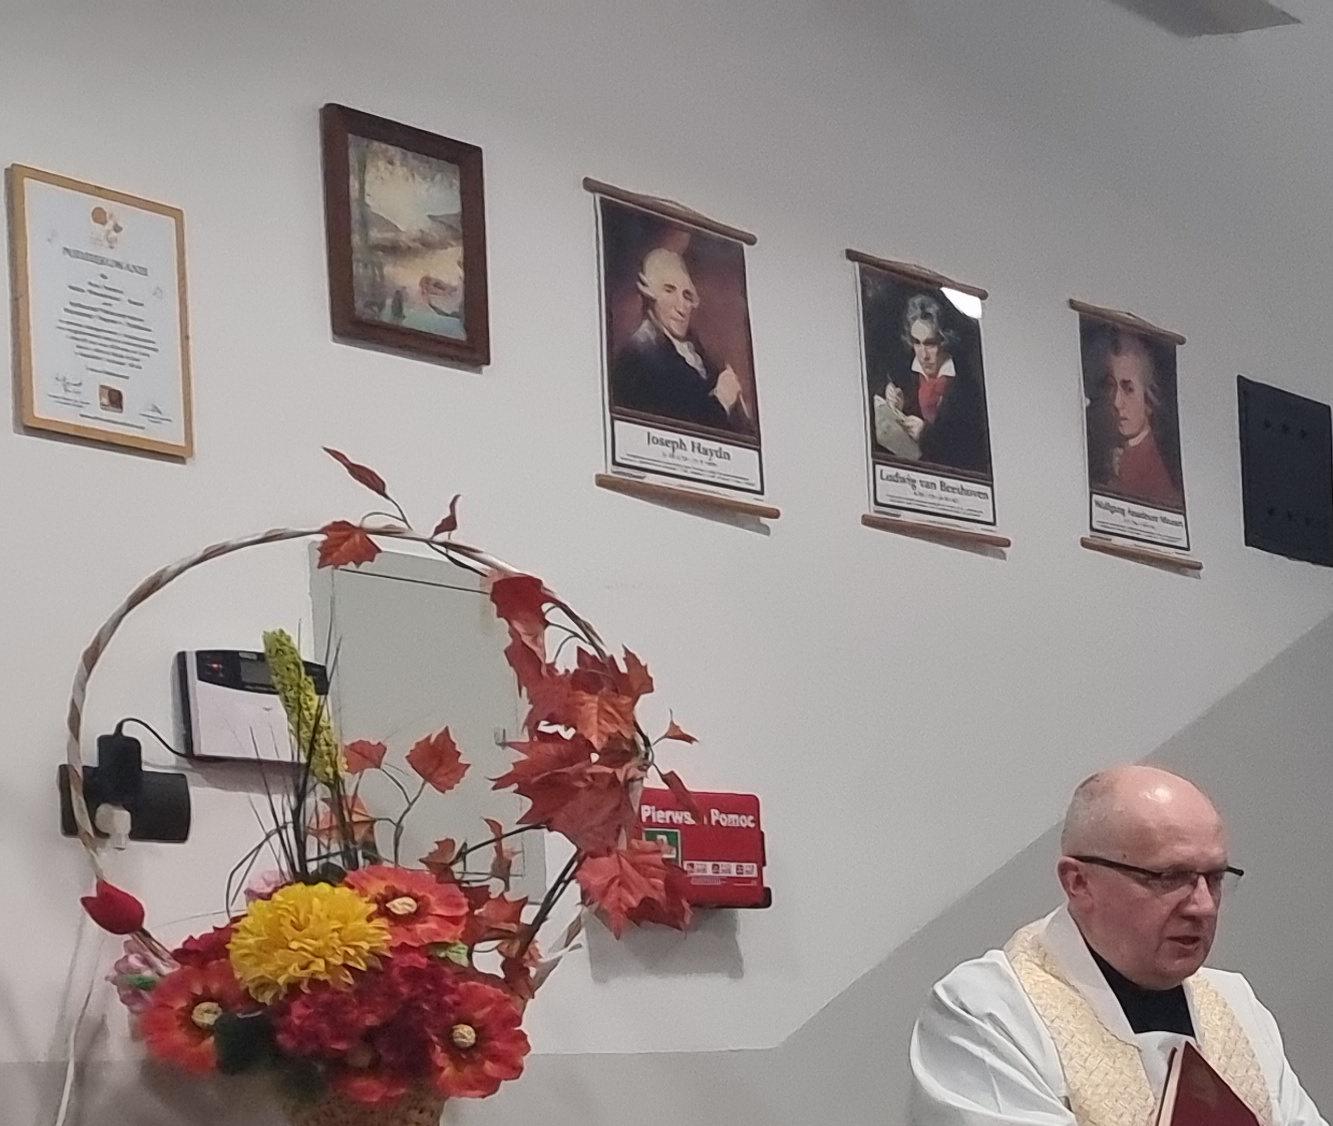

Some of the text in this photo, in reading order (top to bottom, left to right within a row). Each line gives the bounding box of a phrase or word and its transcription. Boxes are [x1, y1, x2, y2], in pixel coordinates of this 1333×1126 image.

[646, 431, 687, 453] Joseph
[691, 440, 731, 462] Haydn
[880, 469, 917, 491] Ludwig
[919, 479, 937, 491] van
[641, 805, 756, 828] Pierws Pomoc
